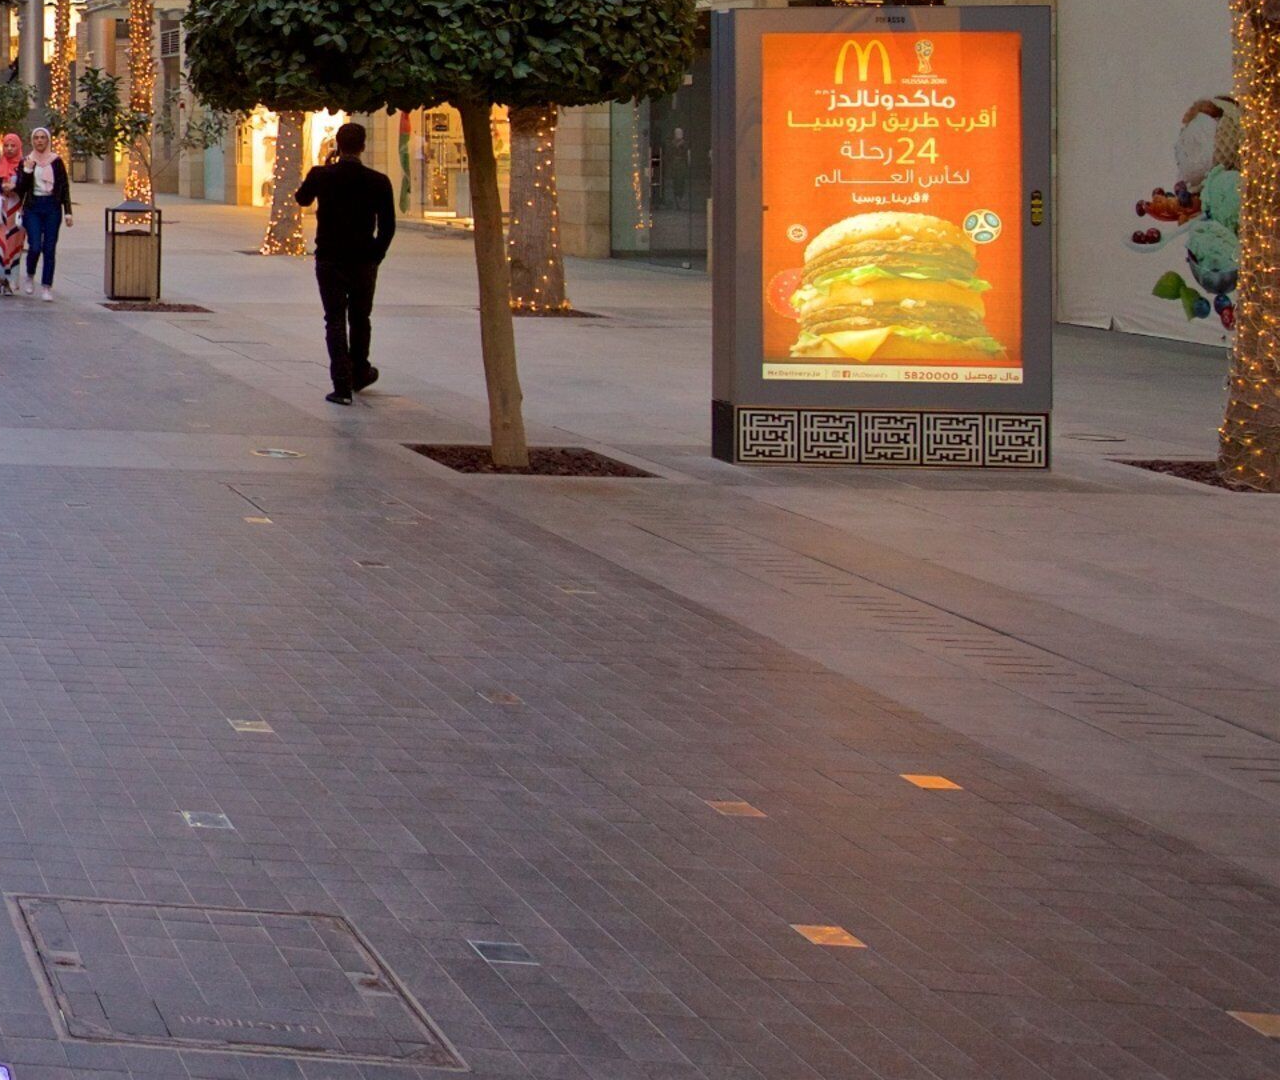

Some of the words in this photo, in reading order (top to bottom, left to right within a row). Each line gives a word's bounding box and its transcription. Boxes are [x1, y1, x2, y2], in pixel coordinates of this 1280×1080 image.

[882, 110, 939, 132] طريق
[946, 106, 997, 132] أقرب
[840, 139, 893, 165] رحلة
[896, 137, 939, 164] 24
[918, 166, 970, 187] لكأس
[904, 371, 958, 380] 5820000
